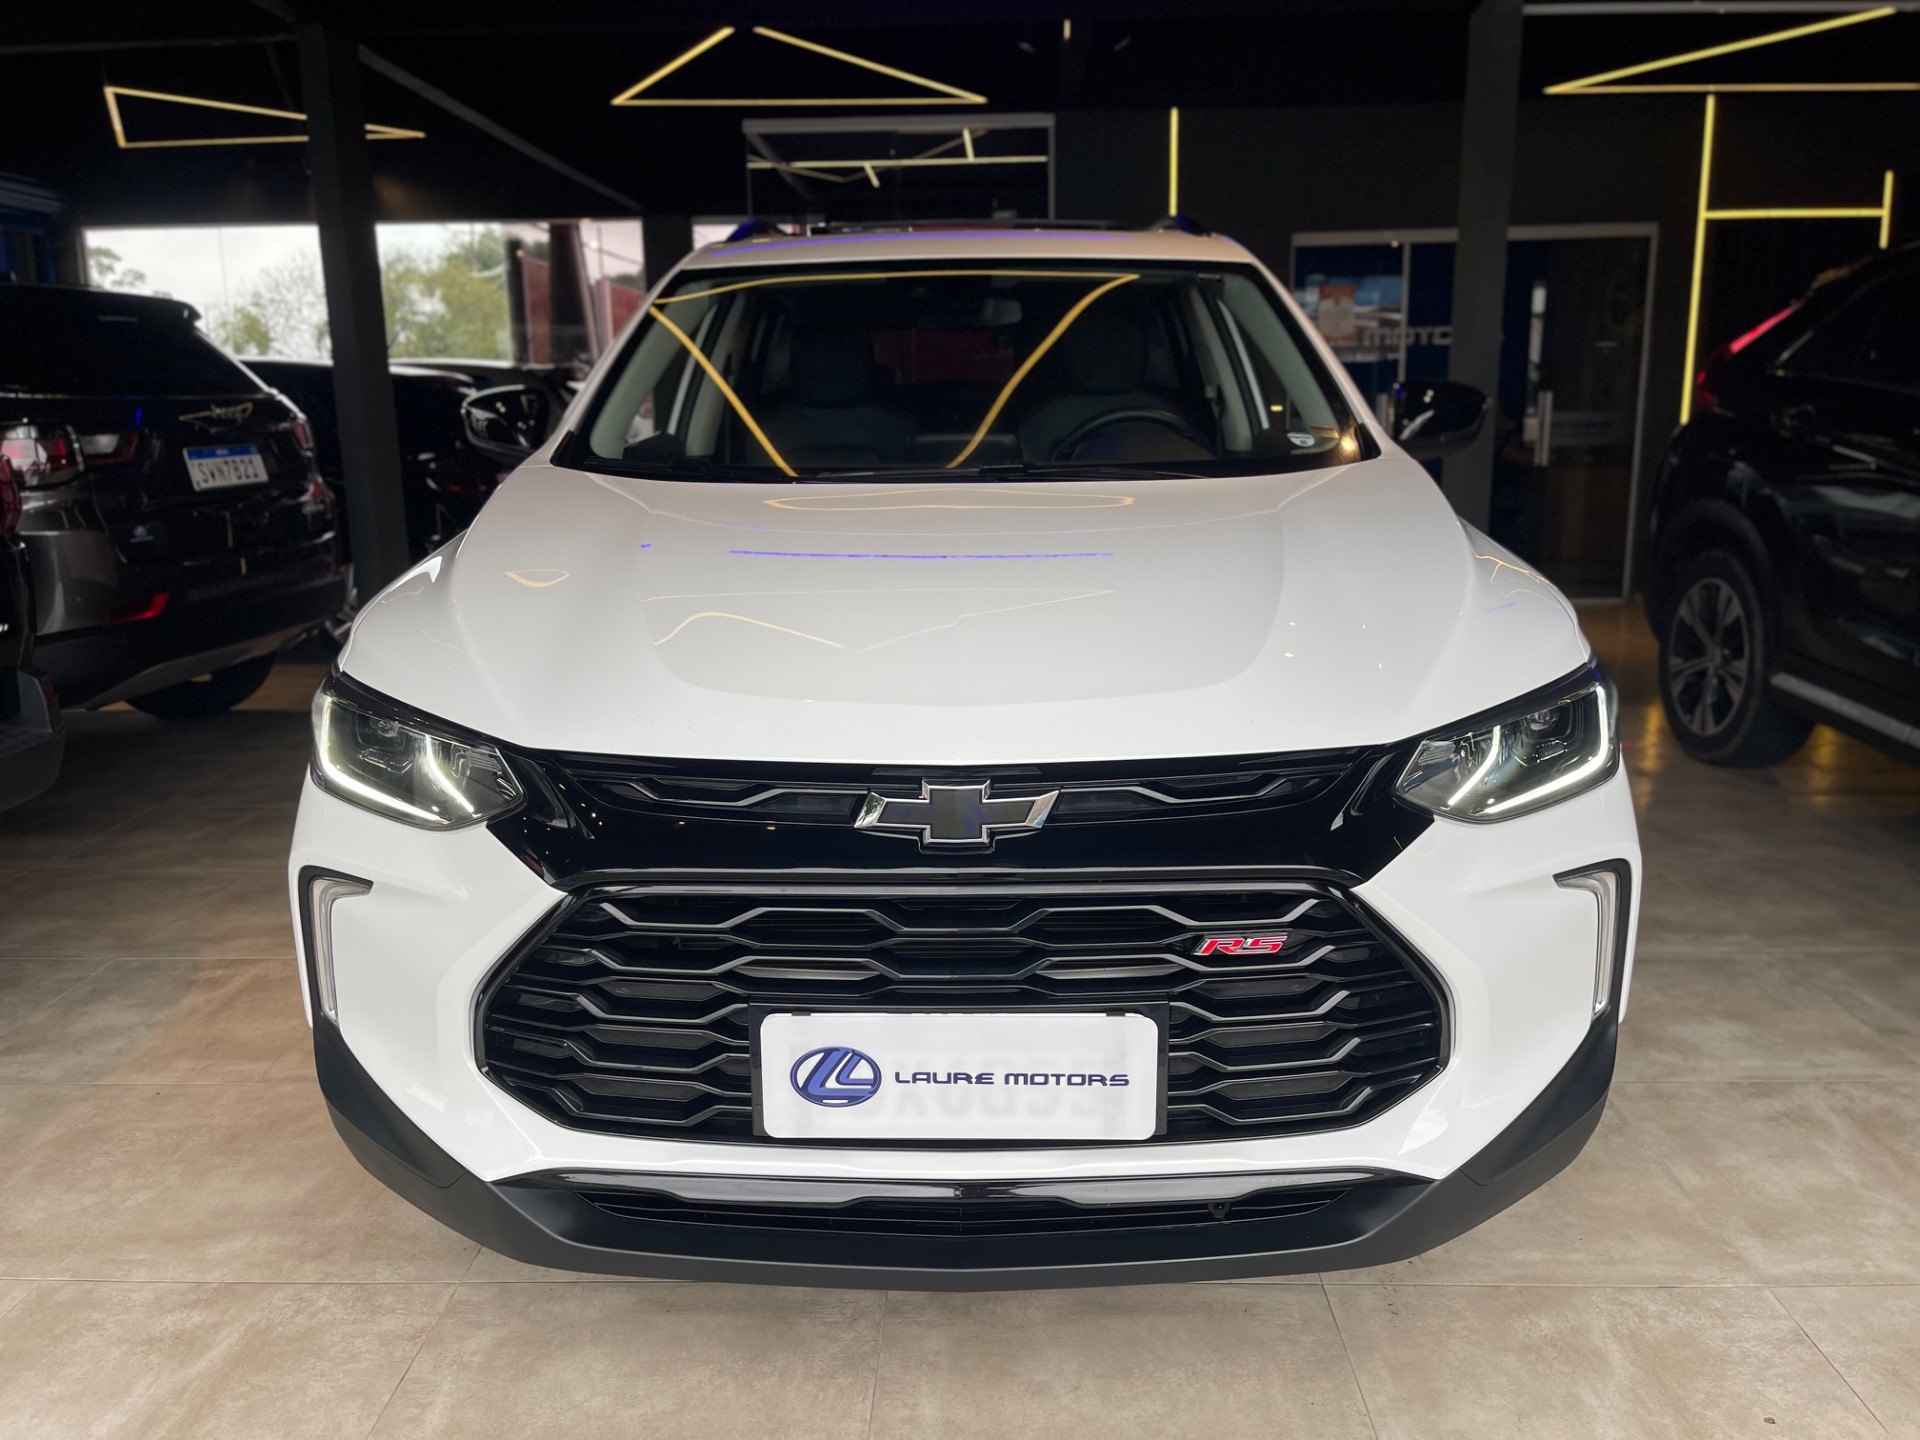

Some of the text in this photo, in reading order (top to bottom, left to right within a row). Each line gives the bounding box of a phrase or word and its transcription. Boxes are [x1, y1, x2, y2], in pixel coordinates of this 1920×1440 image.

[1193, 935, 1288, 956] RS
[894, 1071, 1132, 1087] LAURE MOTORS
